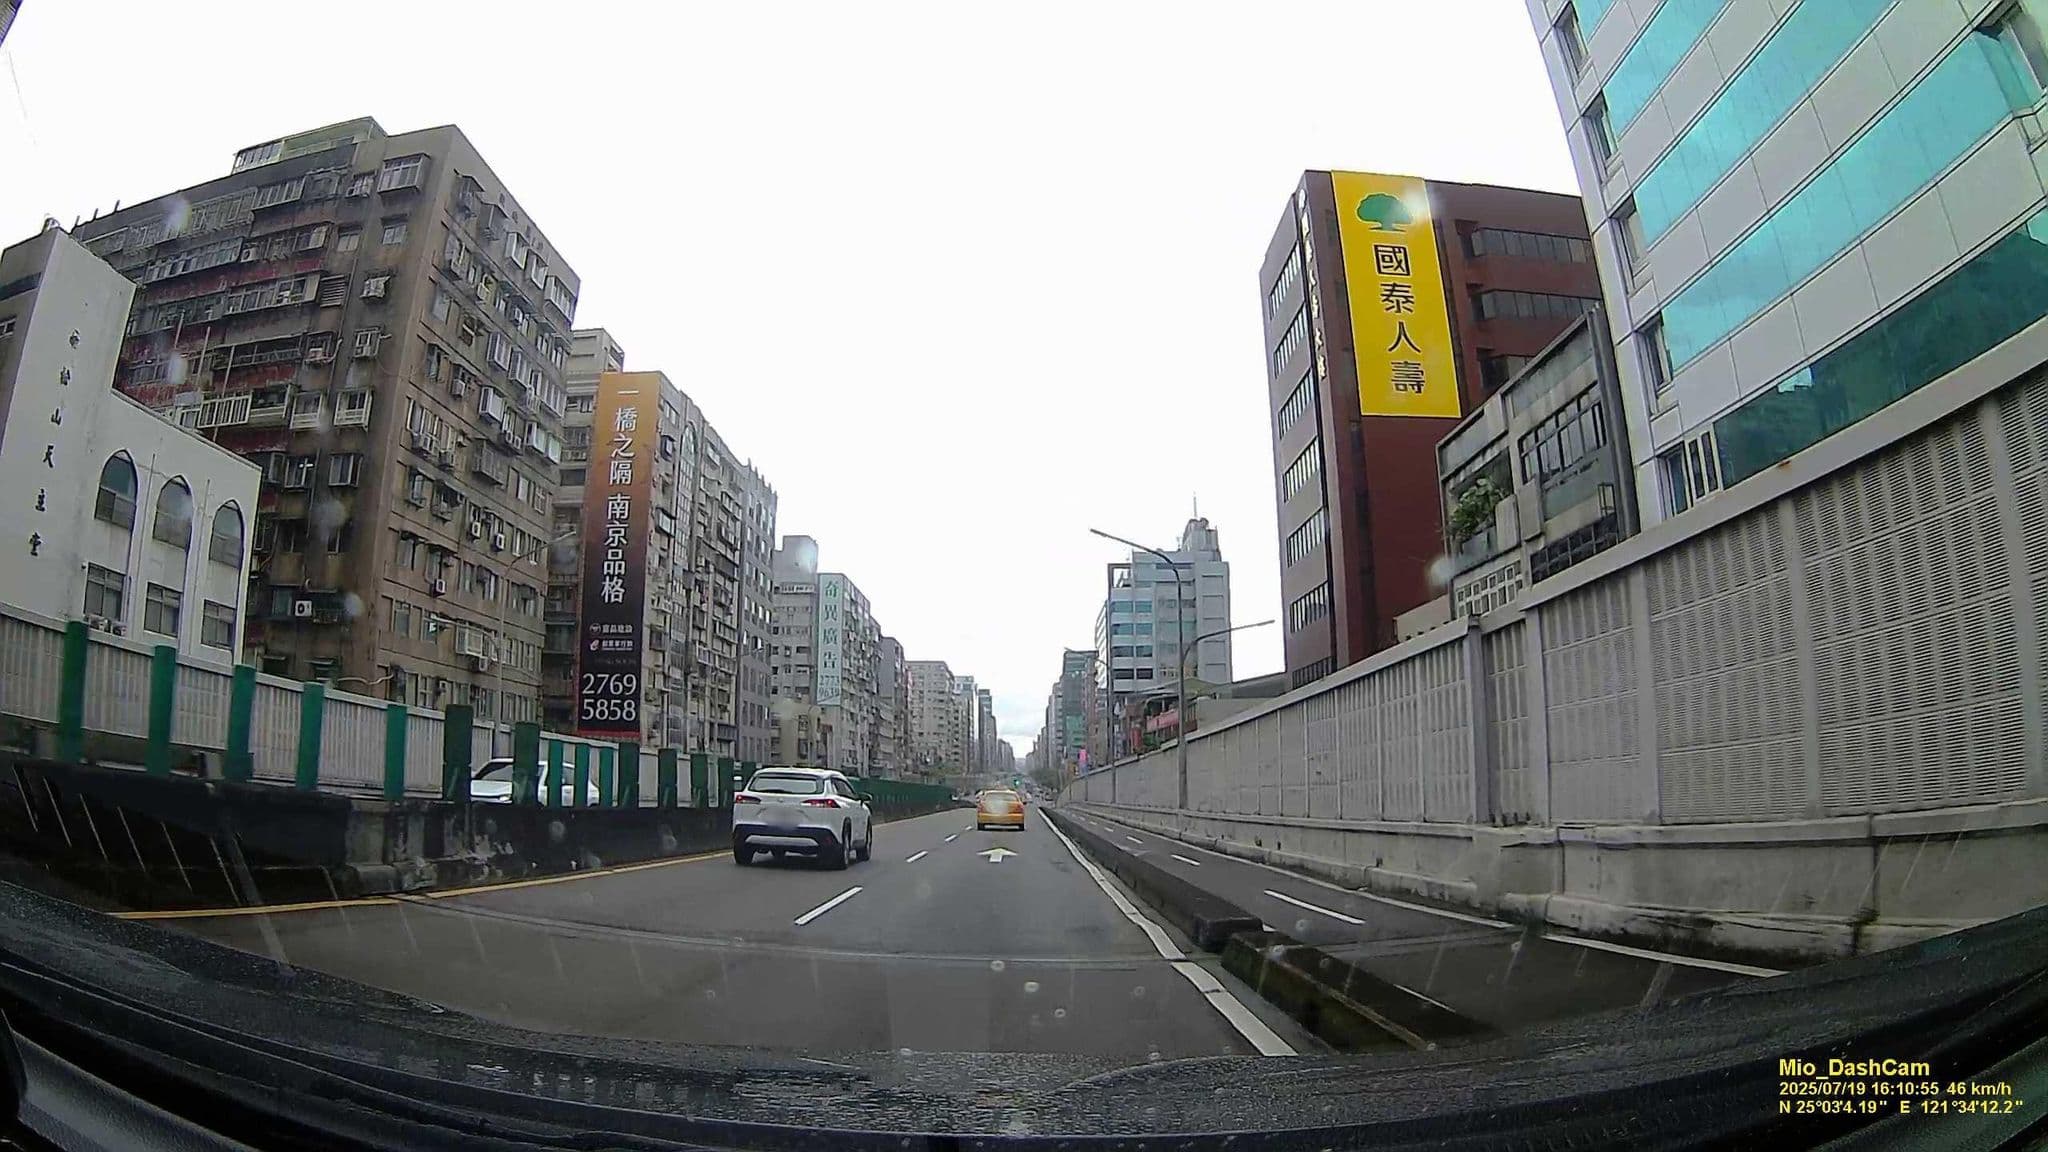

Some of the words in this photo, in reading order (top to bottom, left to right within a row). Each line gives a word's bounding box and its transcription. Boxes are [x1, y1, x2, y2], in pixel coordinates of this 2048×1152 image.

[1373, 244, 1426, 394] 國泰人壽
[608, 389, 639, 486] 一橋之隔
[601, 493, 631, 604] 南京品格
[581, 698, 636, 721] 5858
[582, 673, 637, 695] 2769
